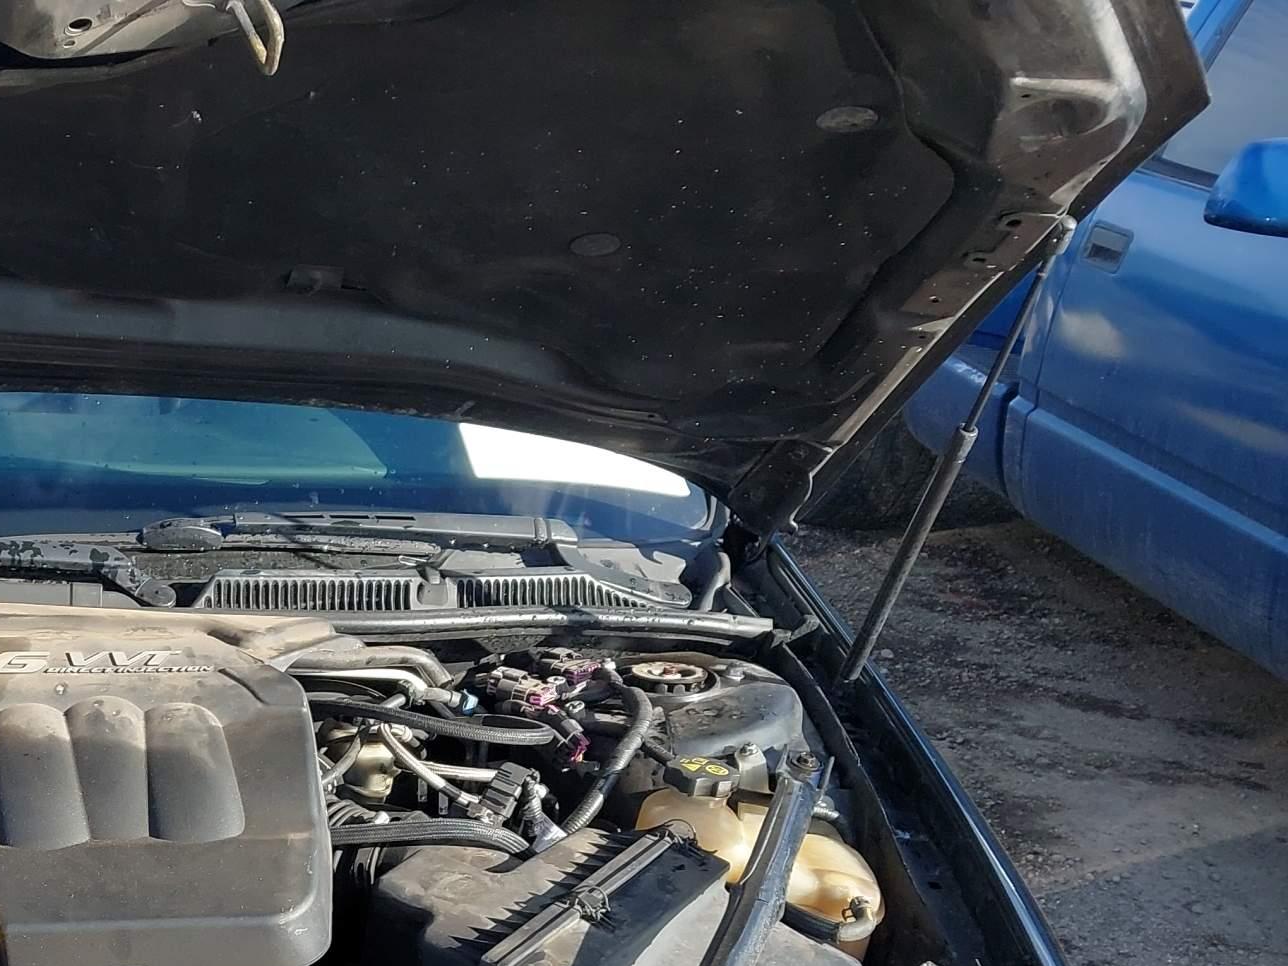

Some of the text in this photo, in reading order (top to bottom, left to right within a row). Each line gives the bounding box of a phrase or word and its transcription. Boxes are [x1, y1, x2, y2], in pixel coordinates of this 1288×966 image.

[65, 650, 183, 666] VVT
[43, 664, 213, 673] DIRECT INJECTION
